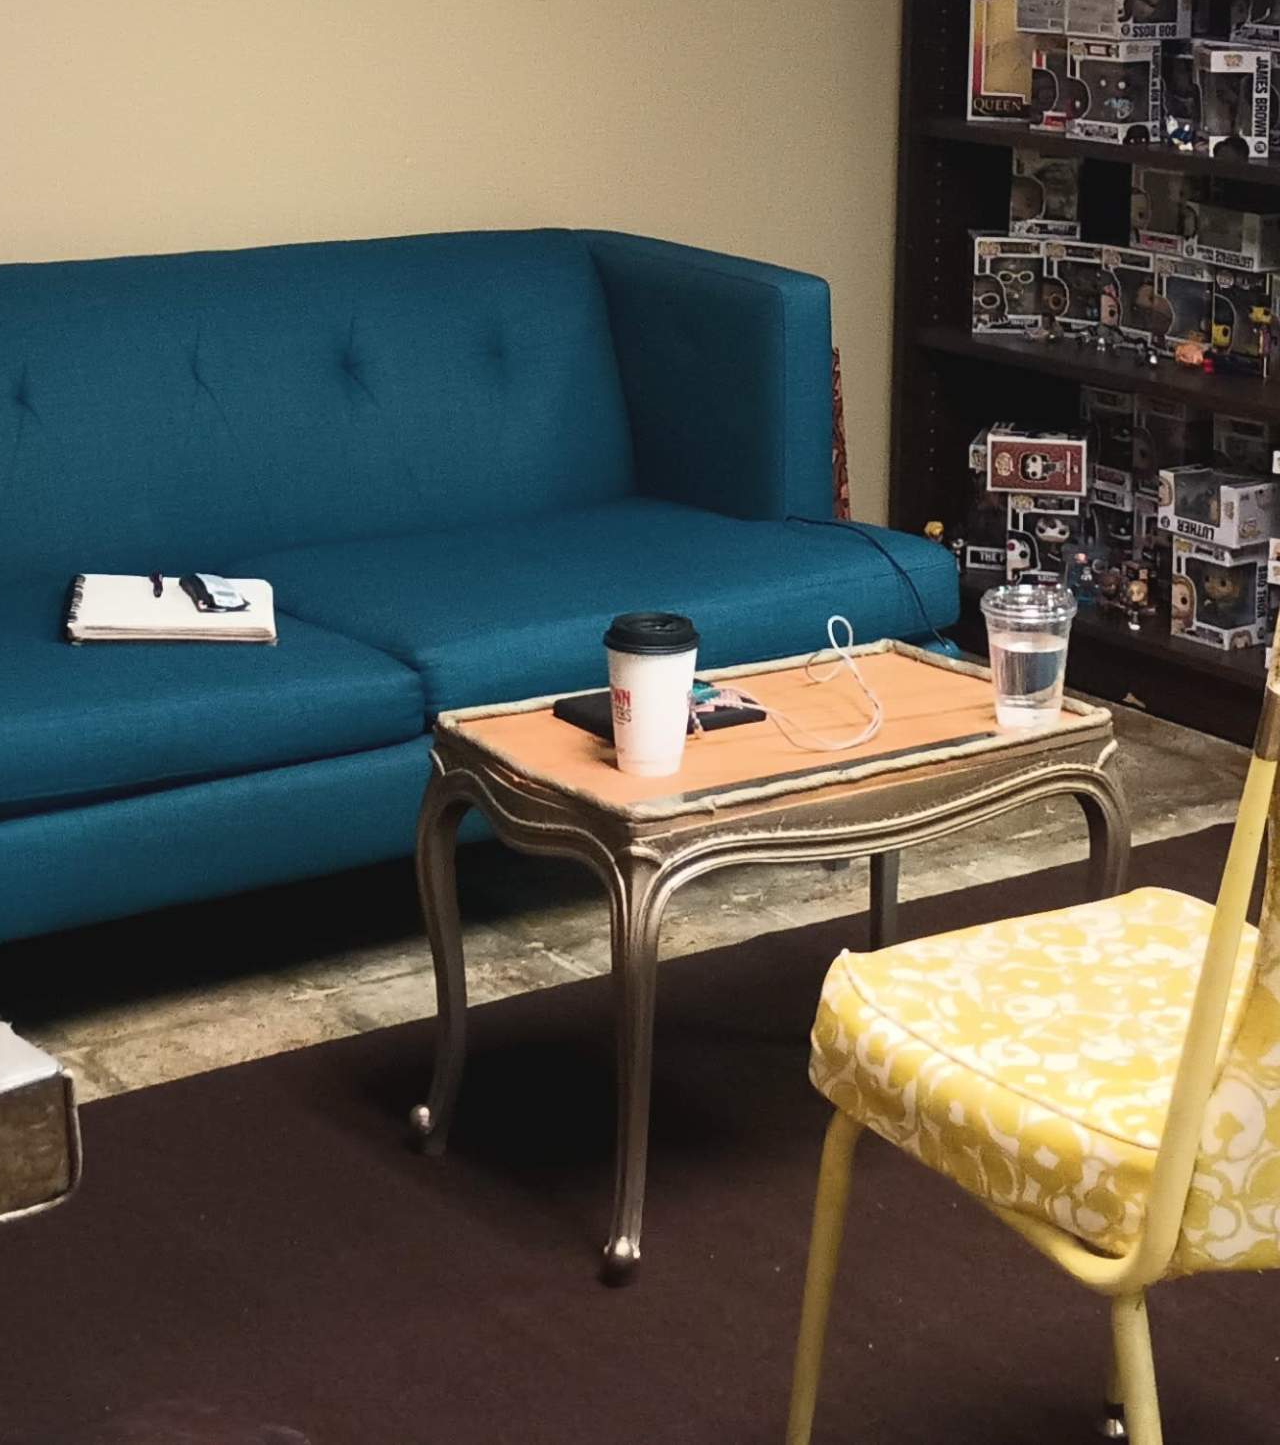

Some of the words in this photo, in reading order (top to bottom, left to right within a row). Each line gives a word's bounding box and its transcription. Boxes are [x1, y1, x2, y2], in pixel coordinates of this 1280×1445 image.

[1255, 56, 1269, 94] JAMES
[1254, 97, 1268, 137] BROWN
[1177, 519, 1215, 541] LUTHER
